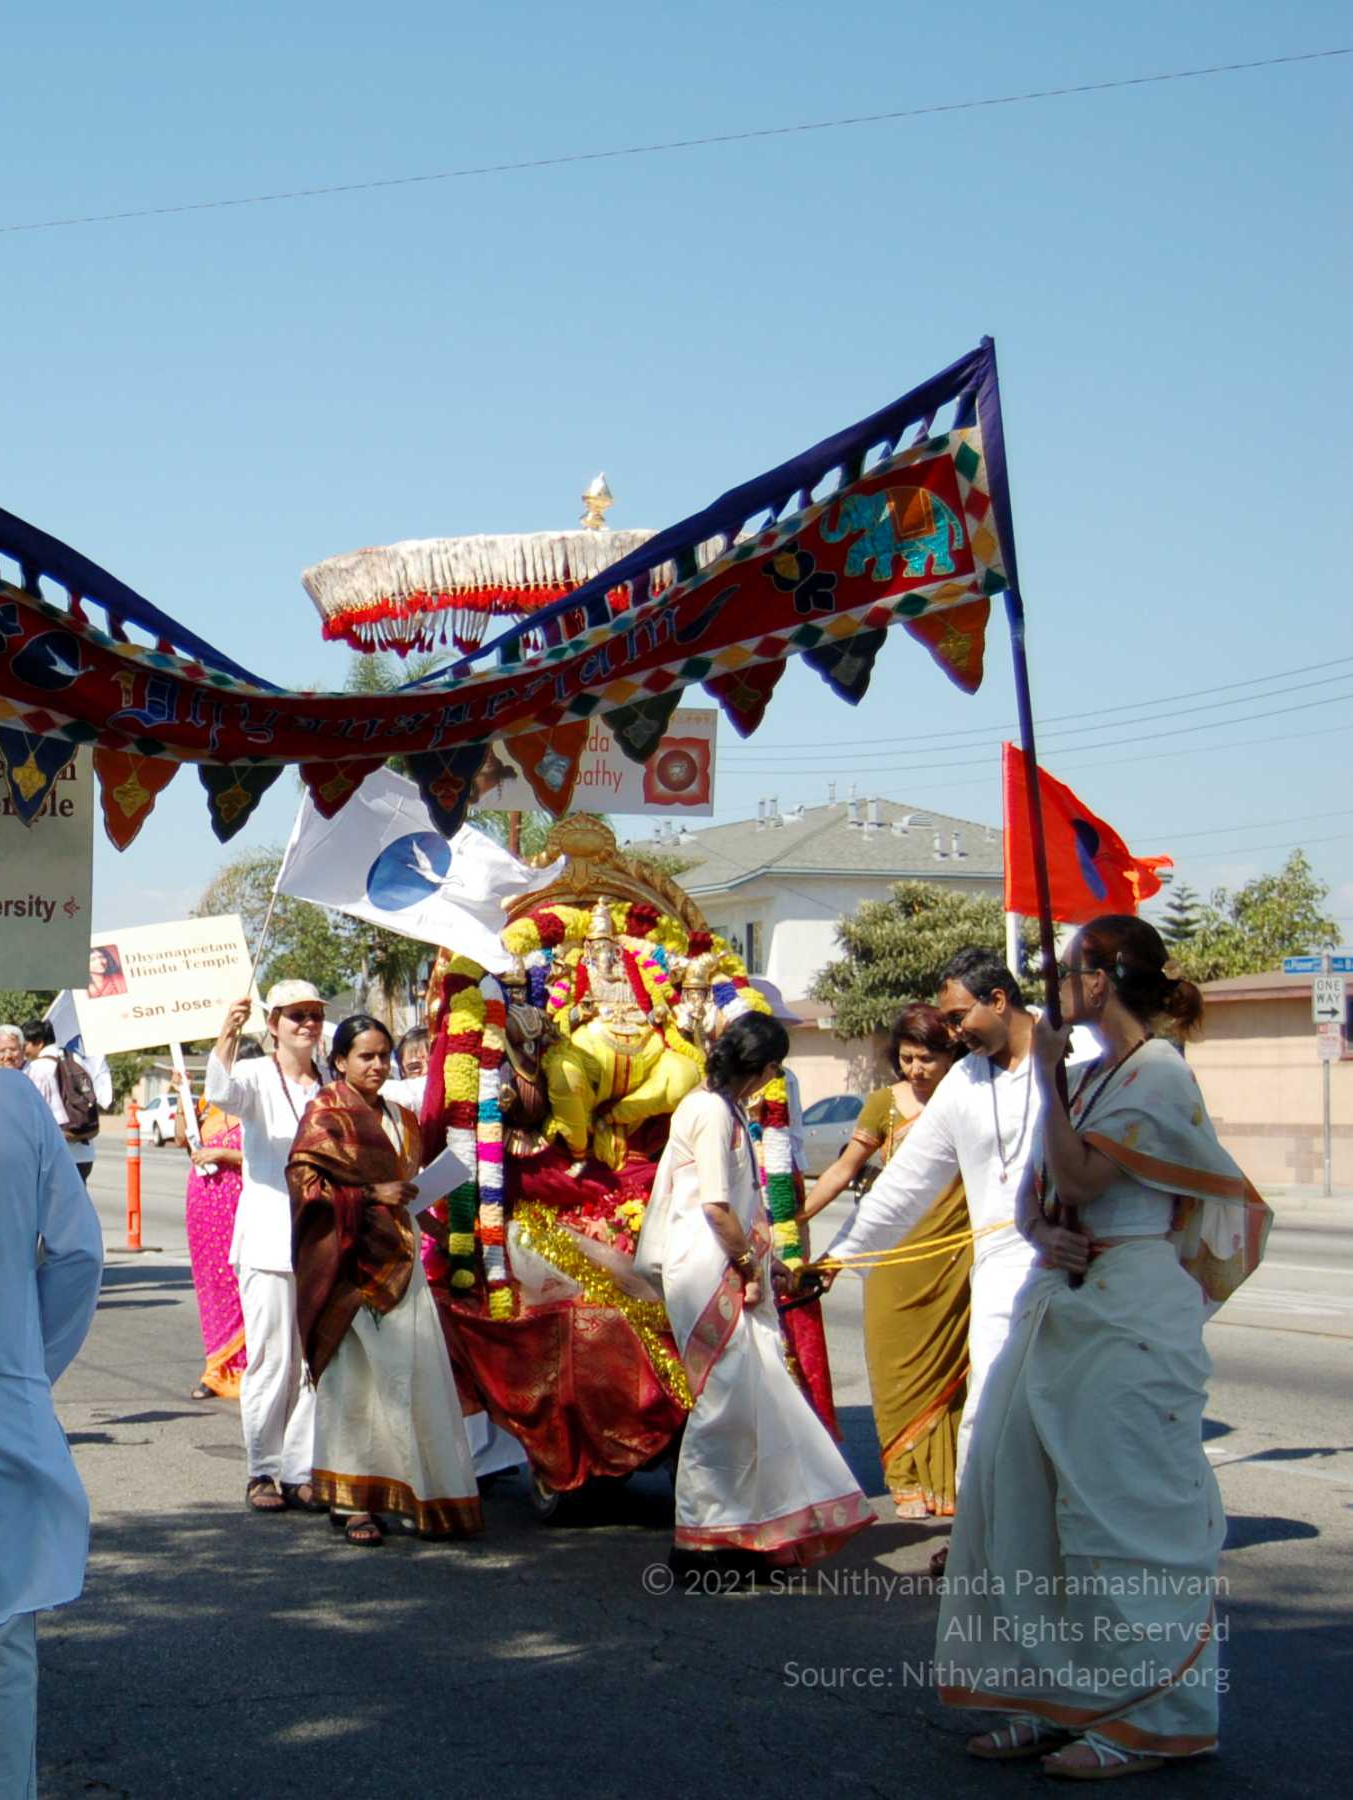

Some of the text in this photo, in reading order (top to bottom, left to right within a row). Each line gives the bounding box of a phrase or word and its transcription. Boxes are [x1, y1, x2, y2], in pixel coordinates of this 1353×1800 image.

[124, 942, 238, 966] Dhyanapeetam
[129, 954, 239, 979] Hindu Temple
[1317, 980, 1341, 992] ONE
[132, 998, 213, 1019] San Jose
[1317, 993, 1341, 1004] WAY
